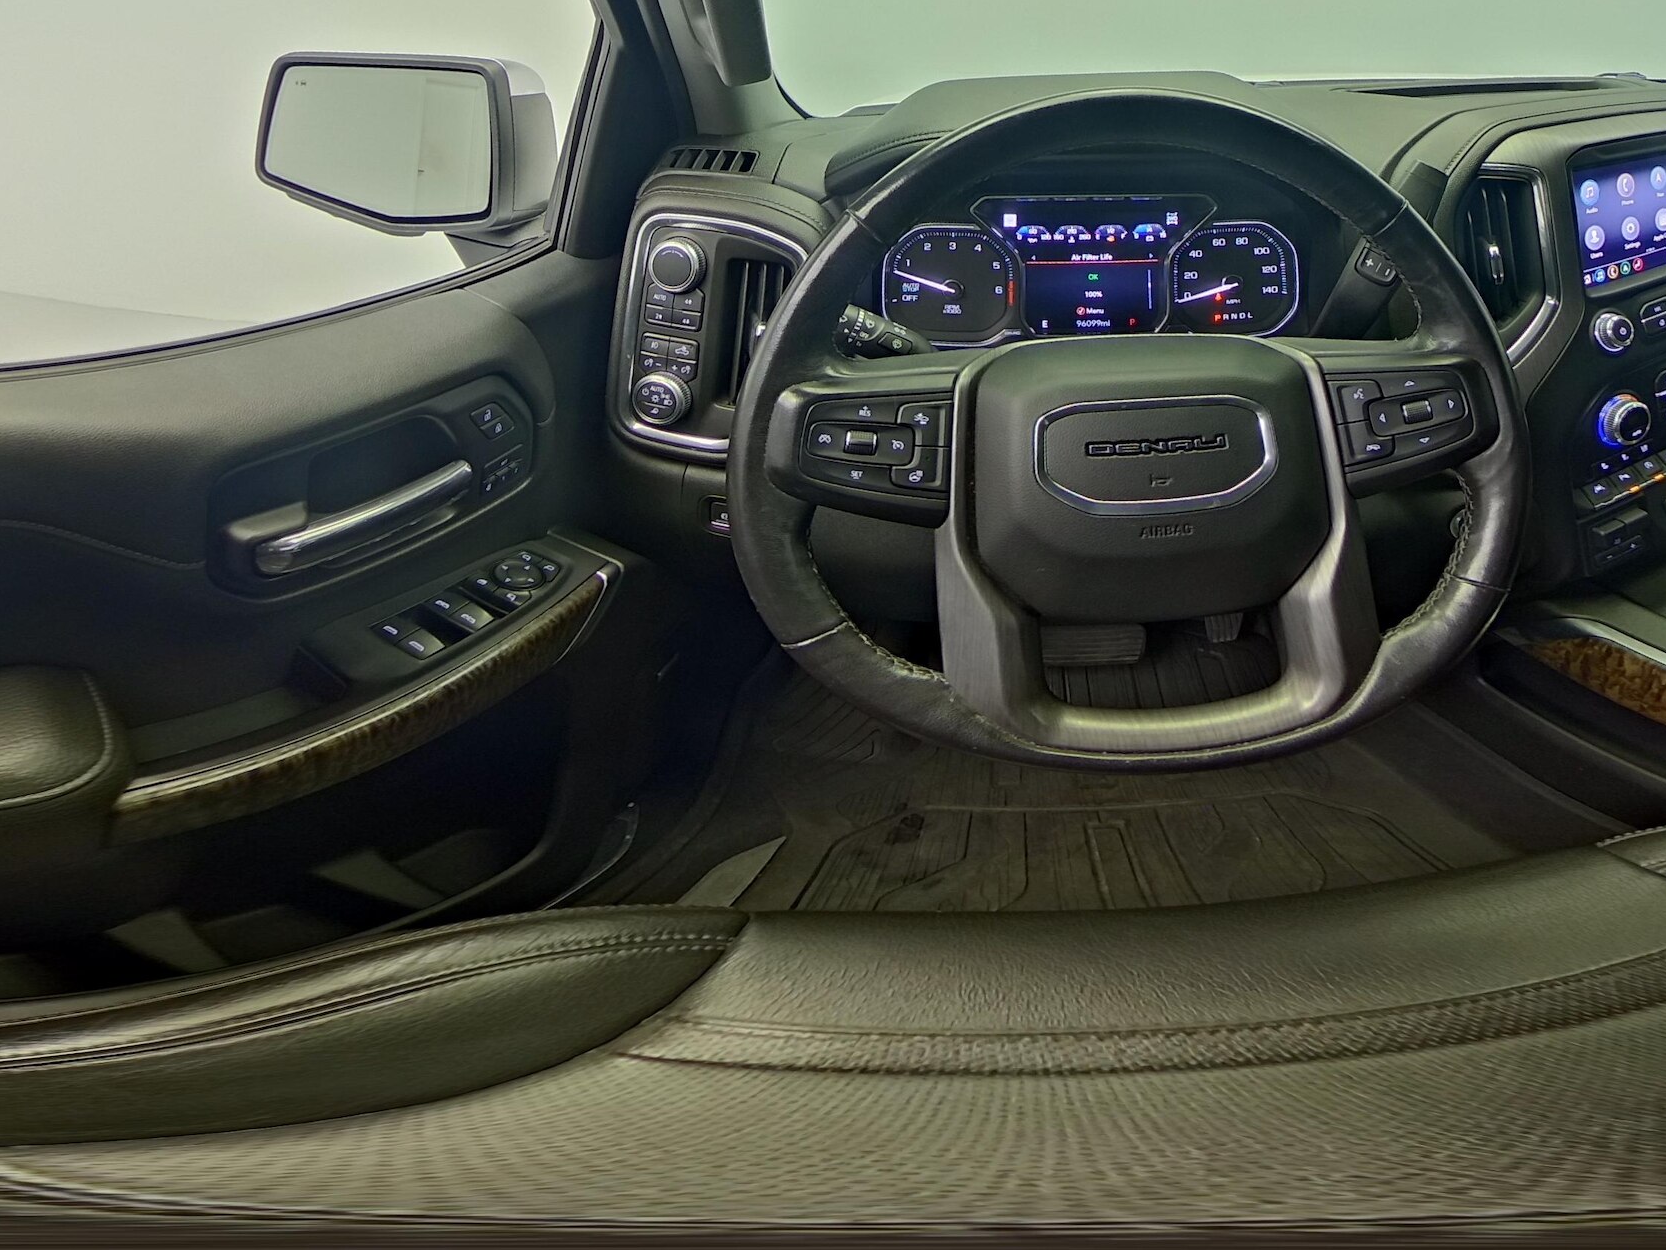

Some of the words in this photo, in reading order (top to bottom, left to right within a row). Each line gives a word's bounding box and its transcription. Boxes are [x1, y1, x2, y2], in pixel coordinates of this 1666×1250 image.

[1212, 238, 1226, 246] 60
[1235, 237, 1249, 245] 80
[924, 243, 932, 251] 2
[949, 242, 956, 250] 3
[974, 244, 982, 252] 4
[1189, 250, 1202, 258] 40
[1253, 247, 1270, 255] 100
[906, 259, 911, 267] 1
[993, 262, 1000, 270] 5
[1261, 265, 1278, 273] 120
[1183, 271, 1198, 279] 20
[995, 286, 1003, 294] 6
[1262, 286, 1278, 294] 140
[653, 293, 667, 301] AUTO
[1042, 320, 1048, 328] E
[1076, 319, 1111, 327] 96099mi
[650, 385, 665, 393] AUTO
[859, 409, 871, 417] RES
[1085, 433, 1230, 458] DENALI
[851, 470, 863, 478] SET
[1139, 524, 1195, 539] AIRBAG
